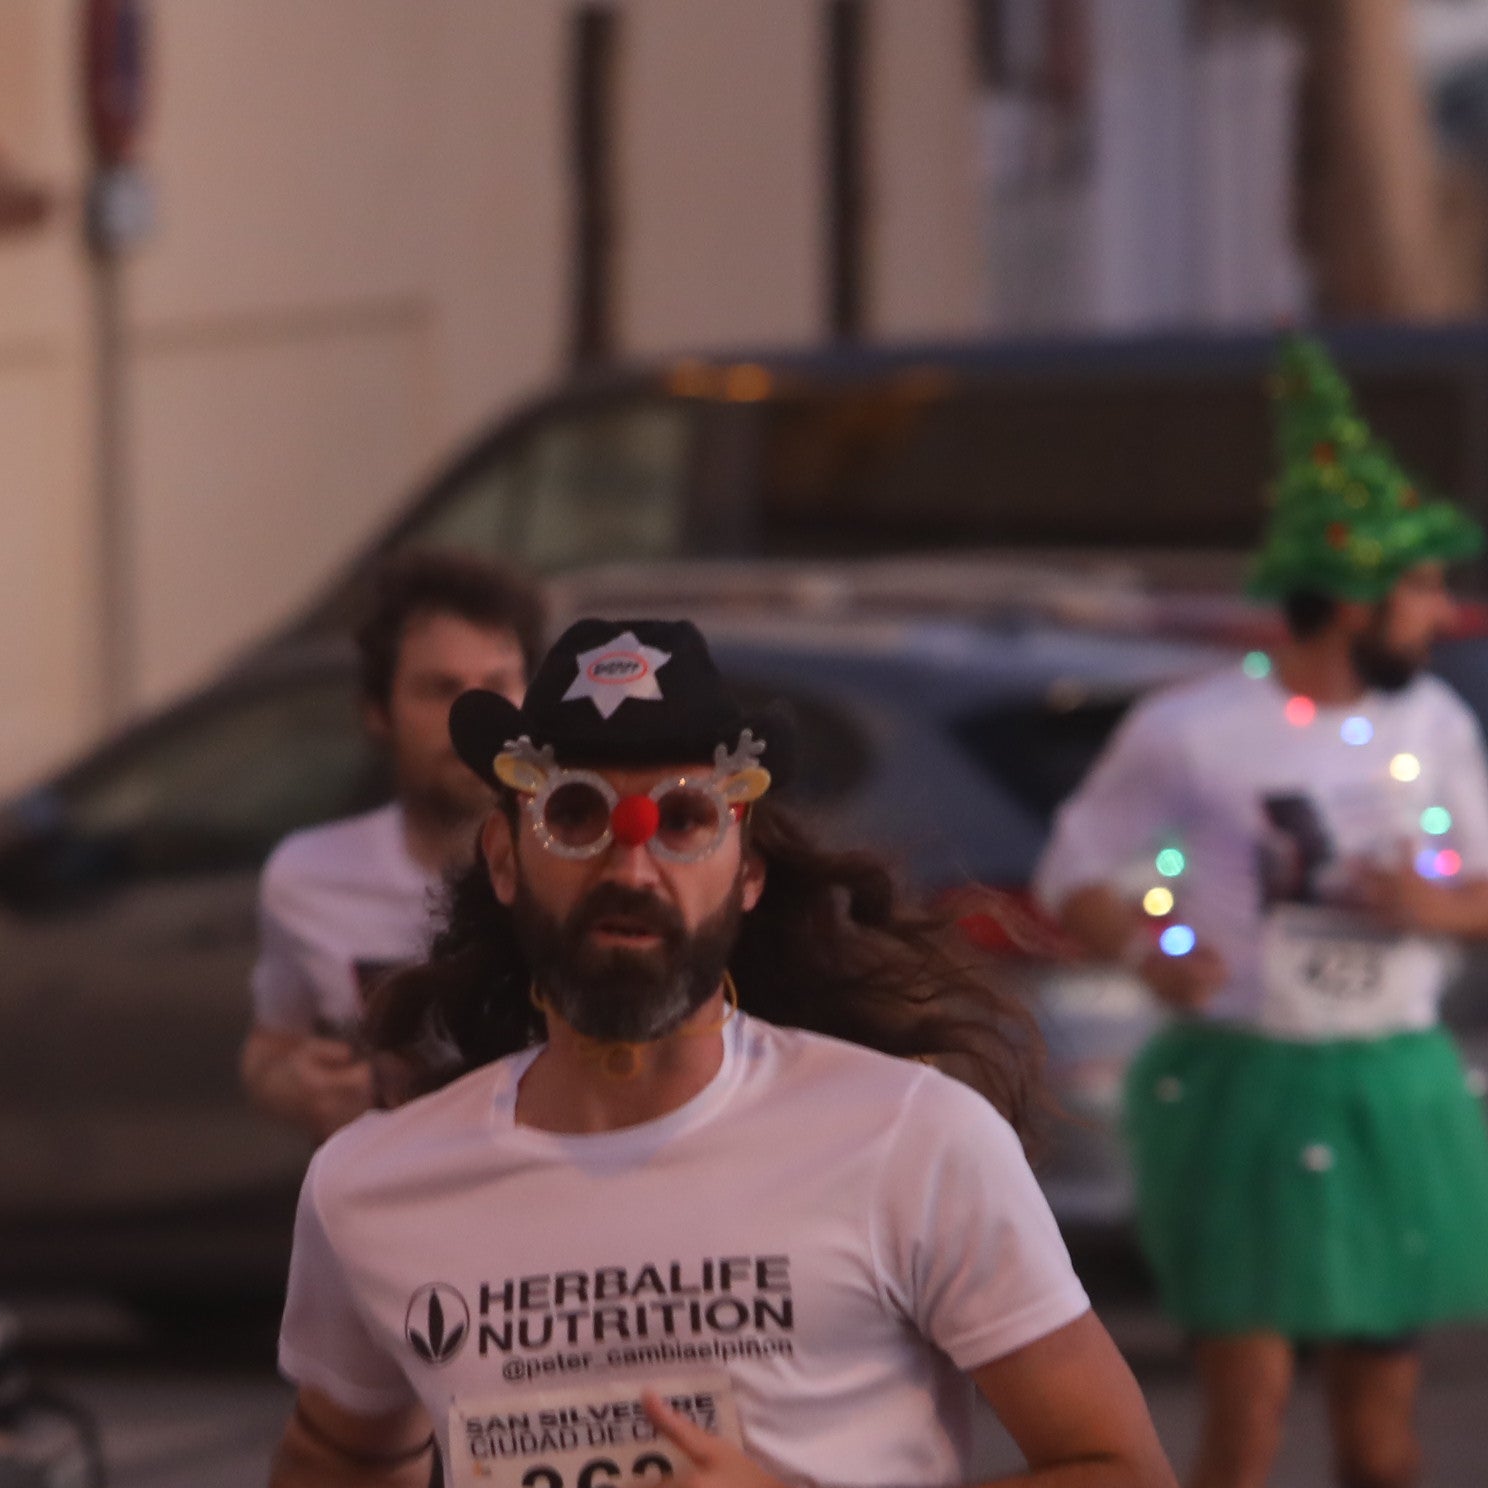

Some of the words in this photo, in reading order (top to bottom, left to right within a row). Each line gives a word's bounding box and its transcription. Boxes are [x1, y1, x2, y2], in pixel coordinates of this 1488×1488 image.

[478, 1253, 792, 1316] HERBALIFE
[477, 1295, 795, 1358] NUTRITION
[466, 1412, 531, 1437] SAN
[539, 1393, 715, 1427] SILVESRE
[469, 1426, 579, 1460] CIUDAD
